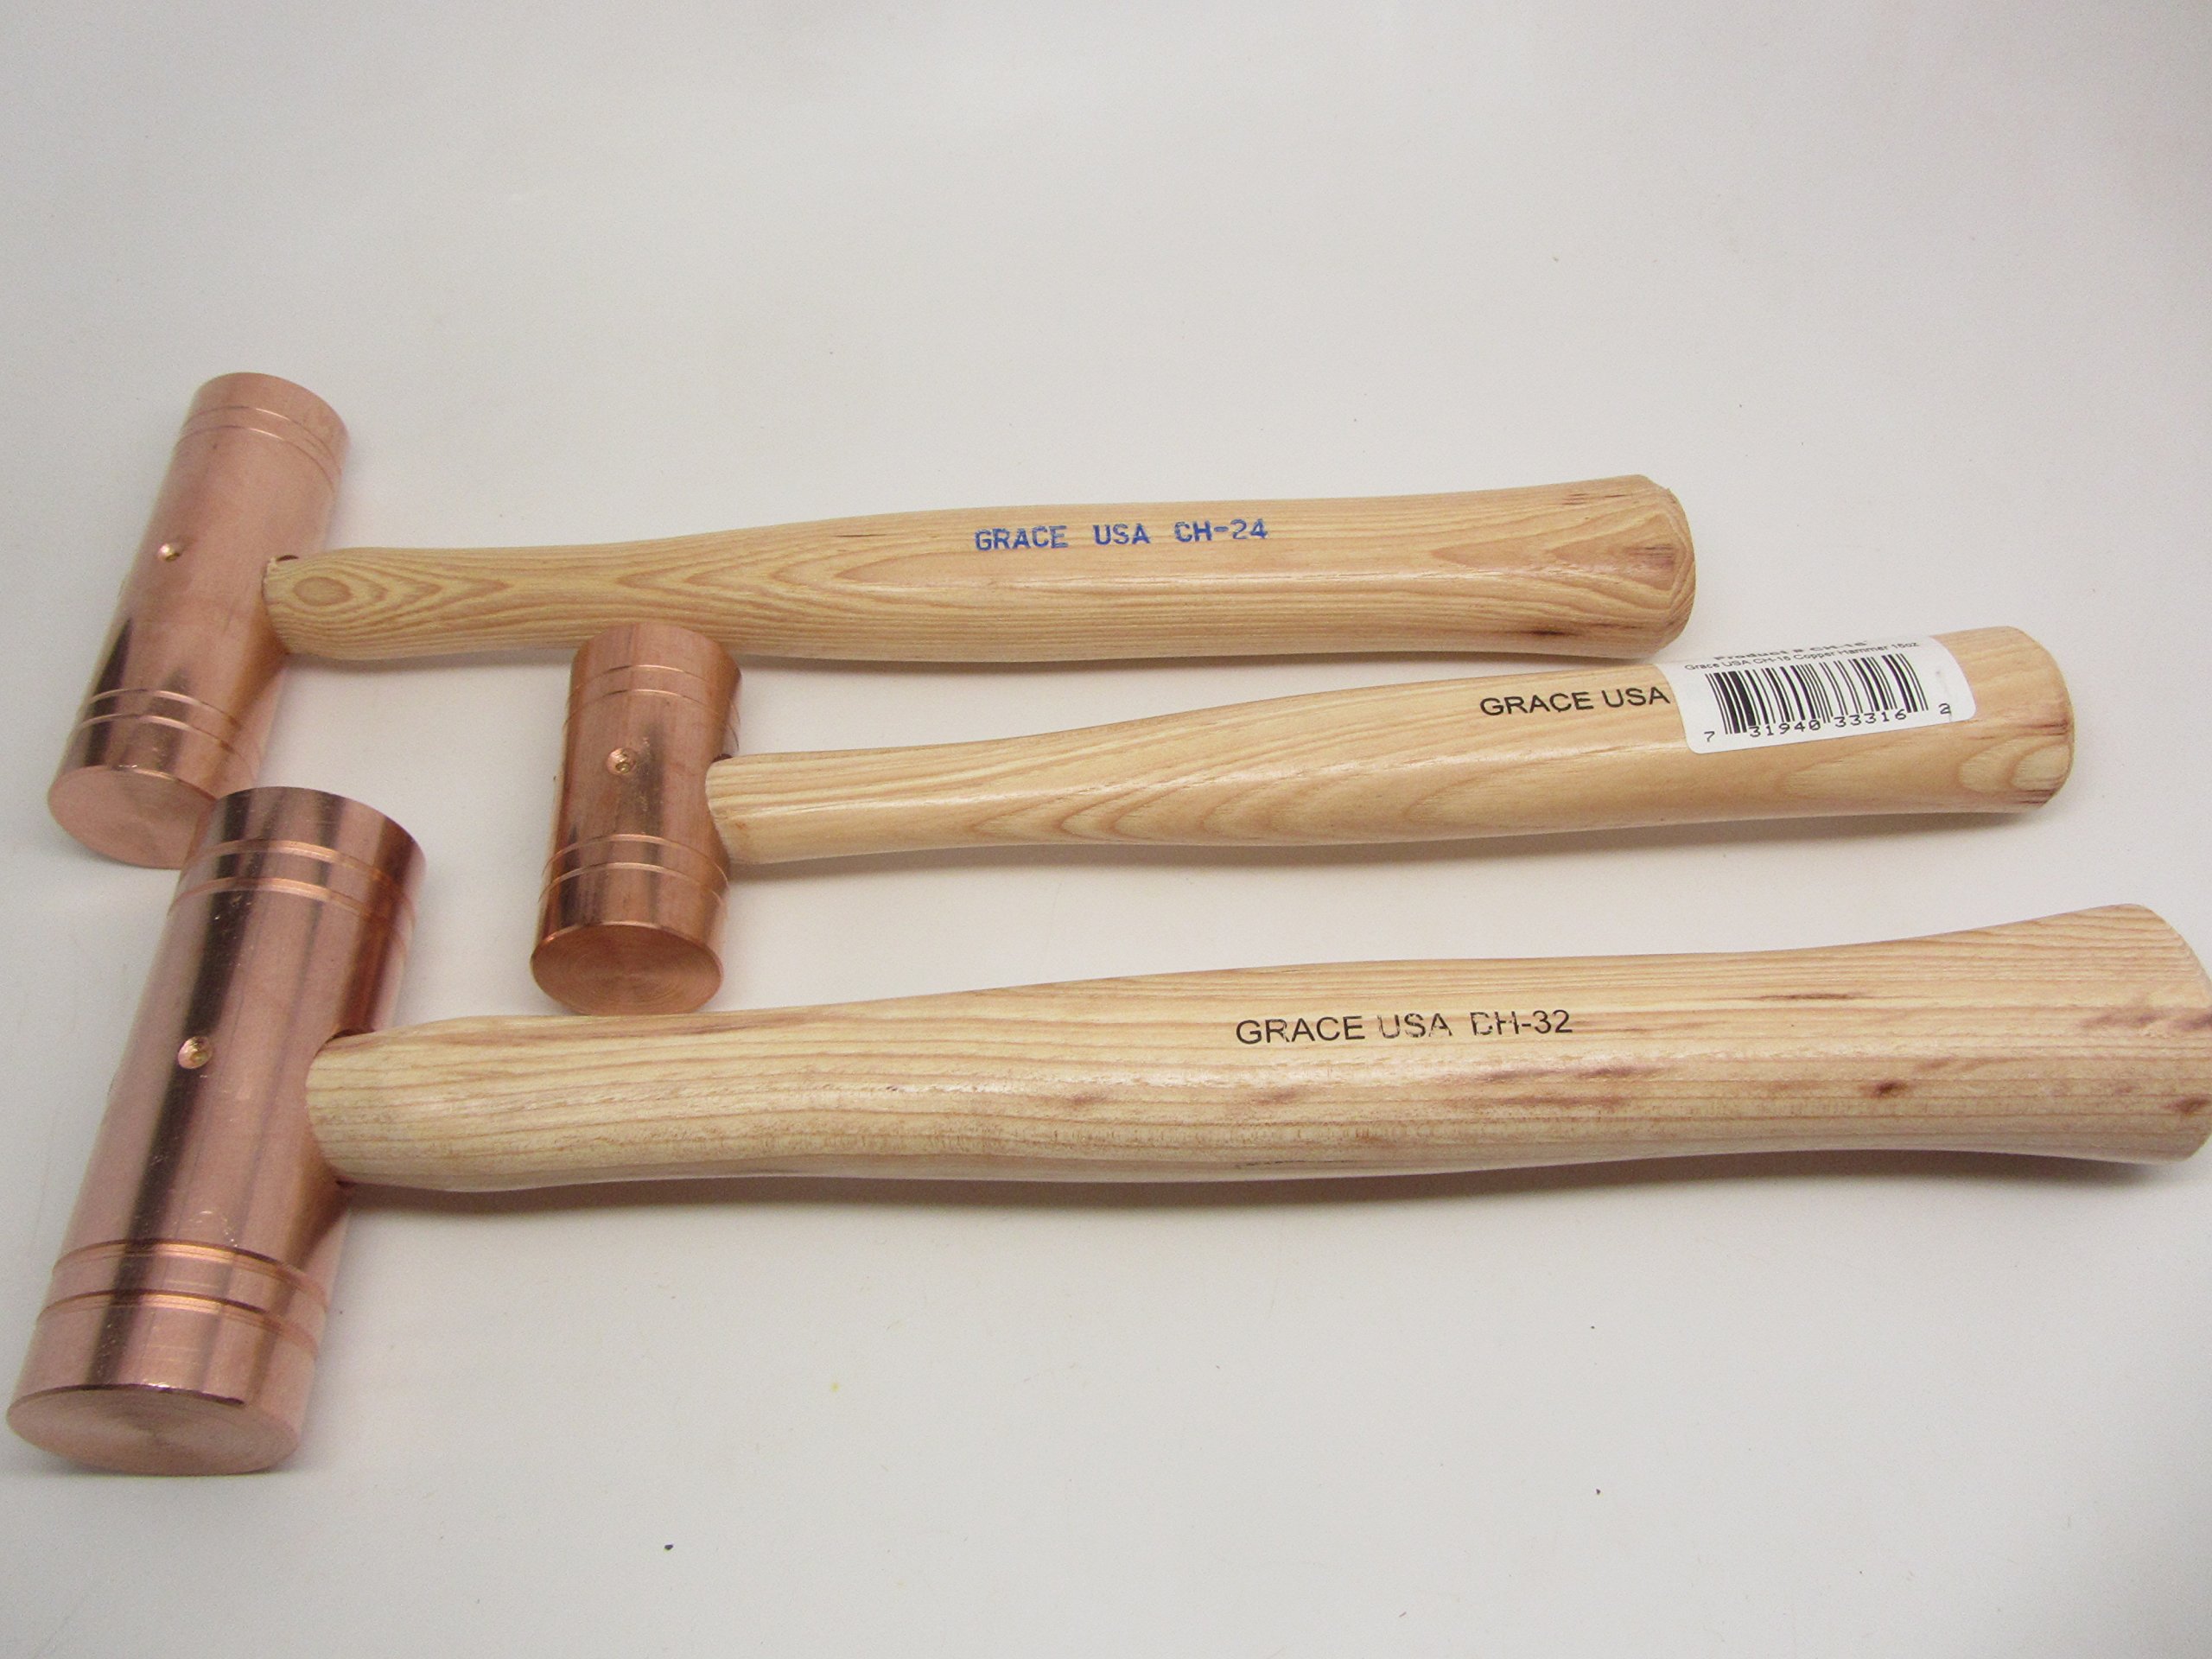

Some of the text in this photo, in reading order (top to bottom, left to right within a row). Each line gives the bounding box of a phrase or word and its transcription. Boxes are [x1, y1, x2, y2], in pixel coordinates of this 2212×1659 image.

[974, 518, 1268, 551] GRACE USA CH-24
[1793, 651, 1835, 660] Copper
[1838, 645, 1888, 655] Hammer
[1479, 686, 1670, 716] GRACE USA
[1704, 703, 1951, 742] 7 31940 33316 2
[1236, 1009, 1573, 1045] GRACE USA CH-32
